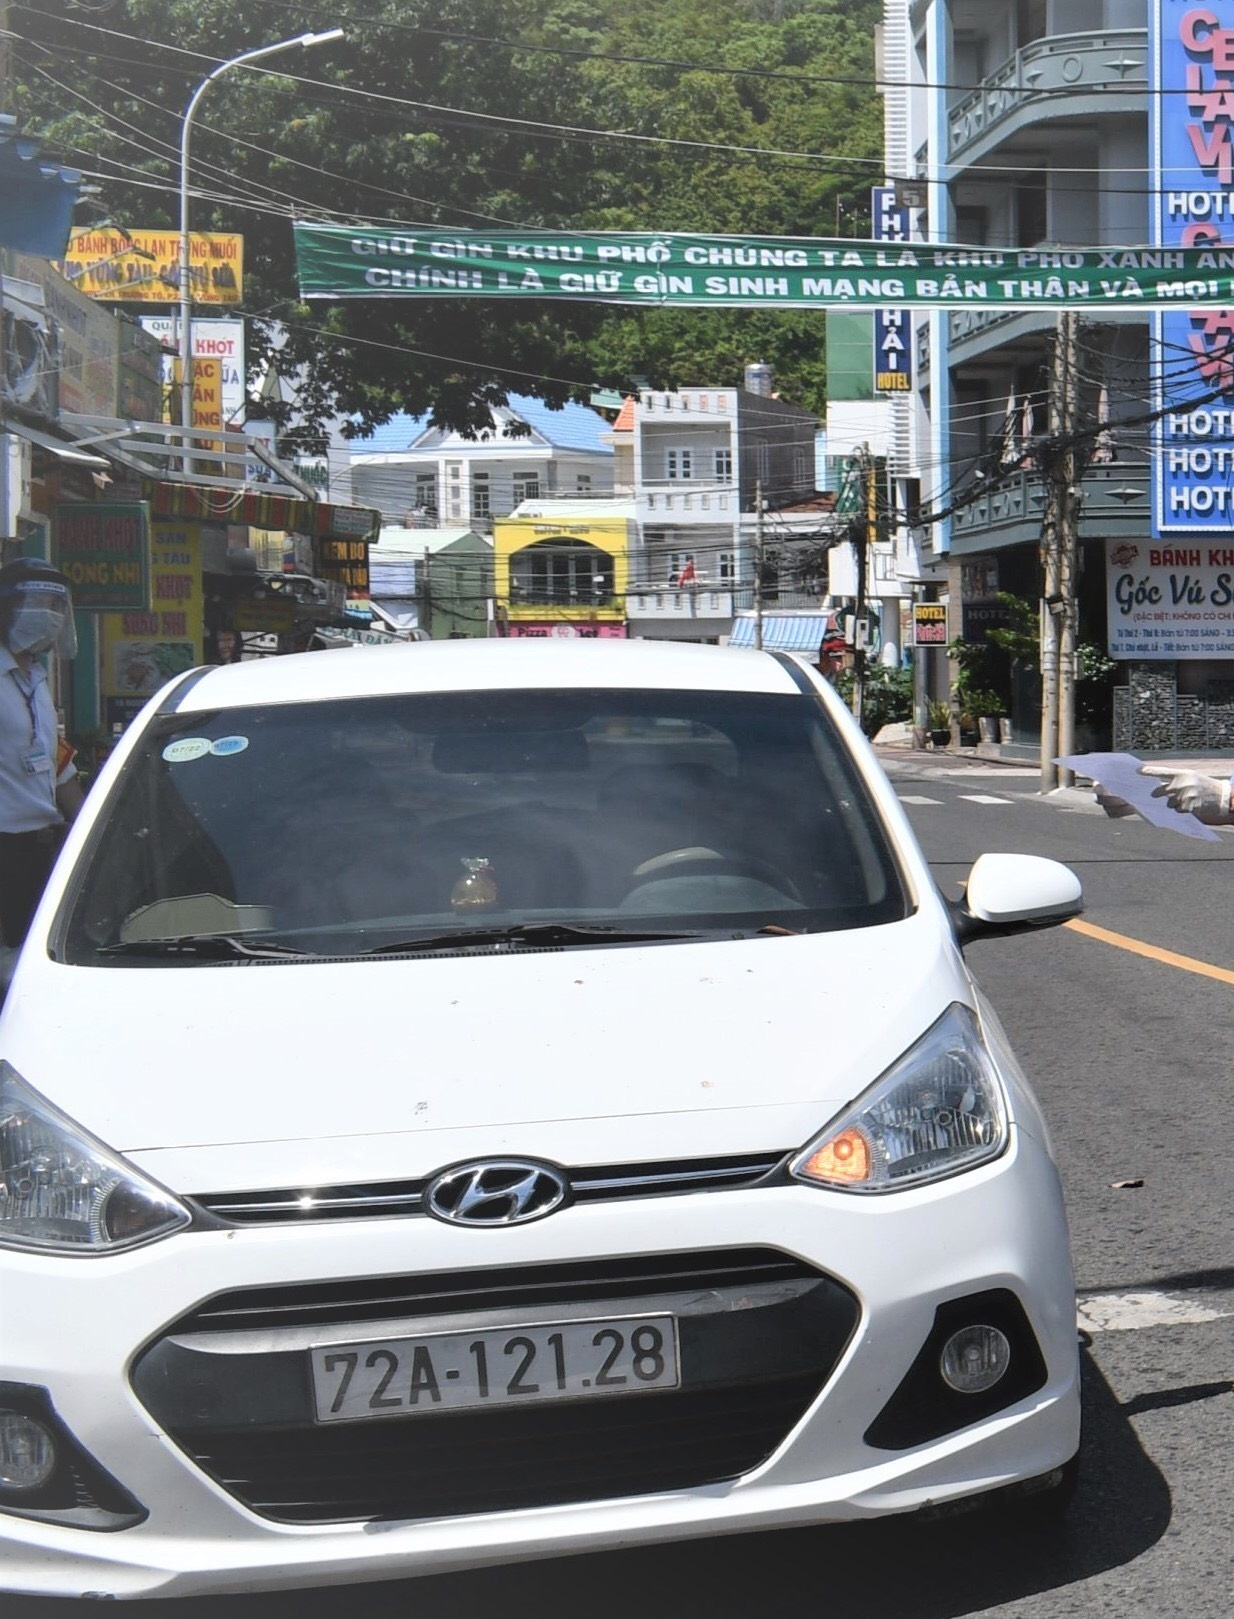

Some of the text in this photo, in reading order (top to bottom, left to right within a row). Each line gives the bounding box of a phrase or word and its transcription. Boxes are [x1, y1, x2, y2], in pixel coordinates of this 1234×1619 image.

[430, 240, 492, 258] GÌN
[507, 245, 583, 262] KHU
[597, 240, 671, 263] PHỐ
[685, 244, 807, 266] CHÚNG
[818, 250, 865, 266] TA
[1099, 252, 1184, 269] XANH
[365, 265, 482, 288] CHÍNH
[498, 268, 544, 290] LÀ
[558, 270, 623, 292] GIỮ
[634, 271, 693, 294] GÌN
[705, 276, 788, 295] SINH
[802, 279, 904, 300] MẠNG
[915, 273, 987, 298] BẢN
[997, 276, 1089, 299] THÂN
[1100, 276, 1143, 298] VÀ
[1156, 281, 1218, 300] MỌI
[877, 372, 910, 391] HOTEL
[1150, 544, 1200, 566] BÁNH
[1115, 574, 1162, 615] Gốc
[1169, 574, 1206, 605] Vú
[916, 606, 945, 619] HOTEL
[1172, 611, 1201, 621] KHÔNG
[1218, 612, 1231, 621] CHI
[325, 1325, 665, 1414] 72A-121.28
